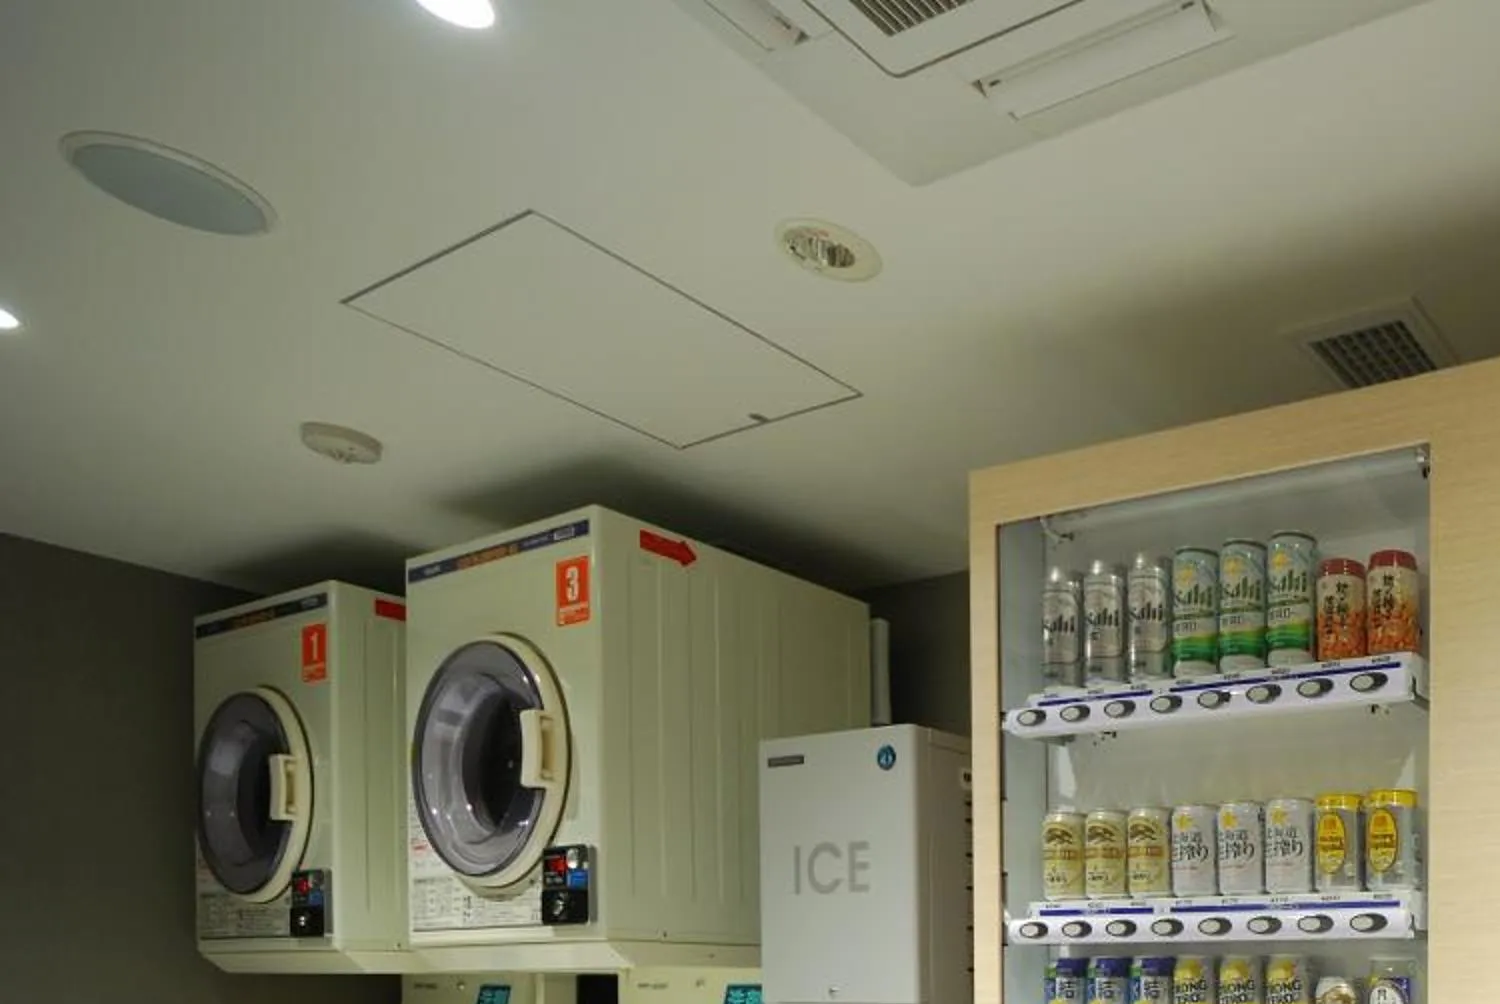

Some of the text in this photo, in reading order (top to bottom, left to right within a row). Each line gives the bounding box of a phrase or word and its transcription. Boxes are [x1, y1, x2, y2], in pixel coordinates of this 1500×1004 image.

[565, 566, 580, 602] 3
[310, 631, 319, 660] 1
[793, 840, 872, 896] ICE
